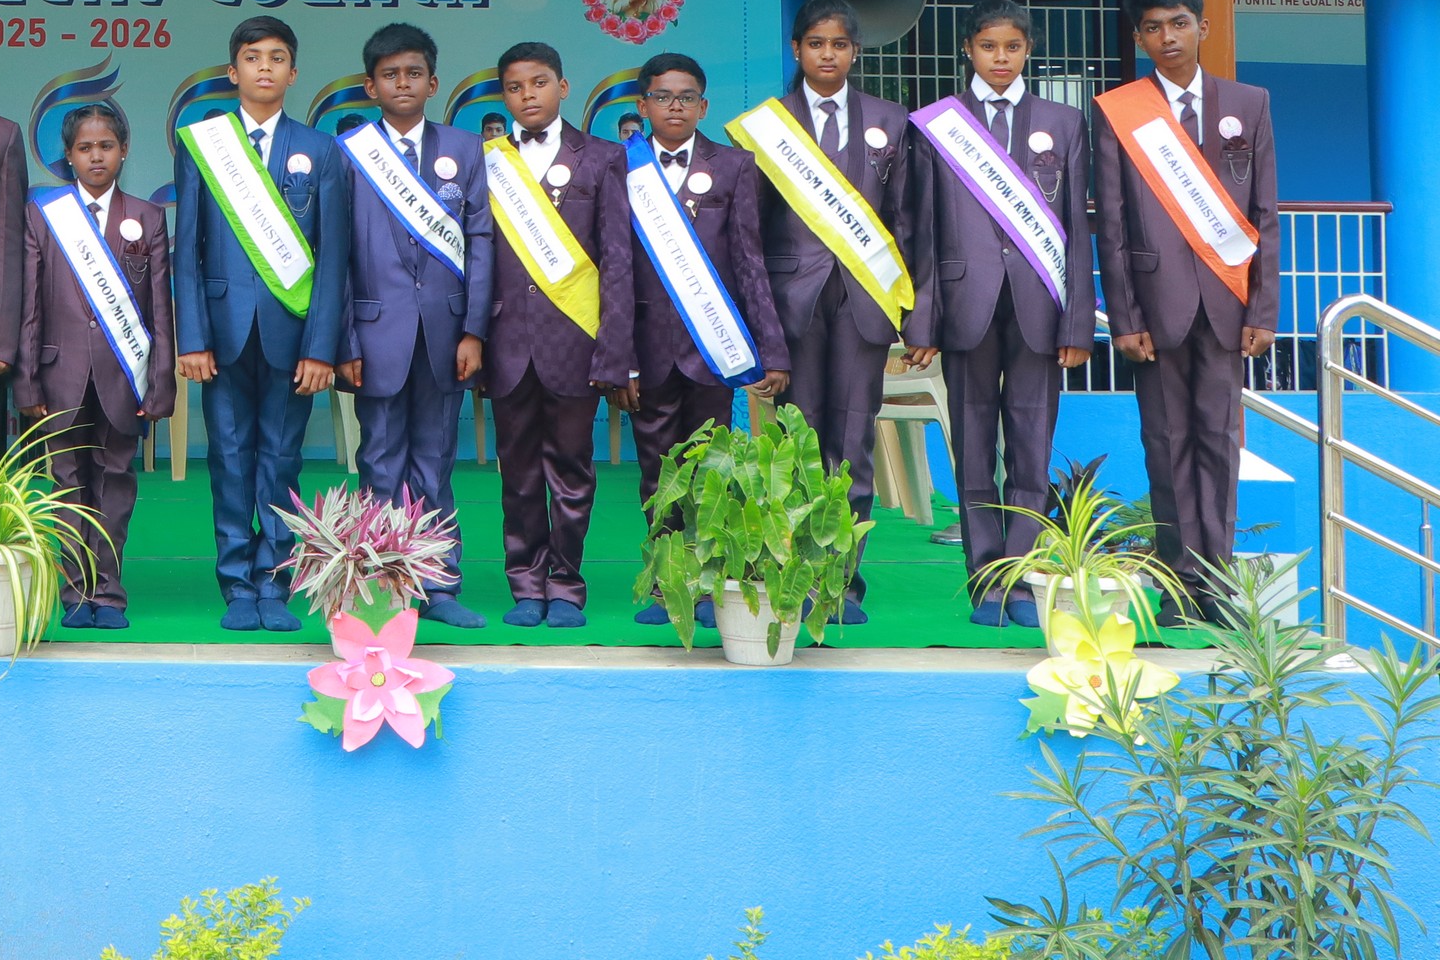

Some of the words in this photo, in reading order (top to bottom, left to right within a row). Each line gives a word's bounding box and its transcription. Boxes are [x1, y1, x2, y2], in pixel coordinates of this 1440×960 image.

[90, 18, 172, 48] 2026
[207, 126, 255, 201] ELECTRICITY
[248, 202, 293, 264] MINISTER
[367, 148, 418, 208] DISASTER
[487, 162, 529, 219] AGRICULTER
[524, 218, 559, 267] MINISTER
[776, 138, 823, 190] TOURISM
[819, 188, 872, 248] MINISTER
[947, 126, 983, 164] WOMEN
[978, 160, 1046, 237] EMPOWERMENT
[1158, 144, 1193, 188] HEALTH
[1188, 187, 1228, 238] MINISTER
[92, 270, 117, 305] FOOD
[111, 305, 144, 362] MINISTER
[653, 214, 708, 297] ELECTRICITY
[701, 301, 742, 364] MINISTER
